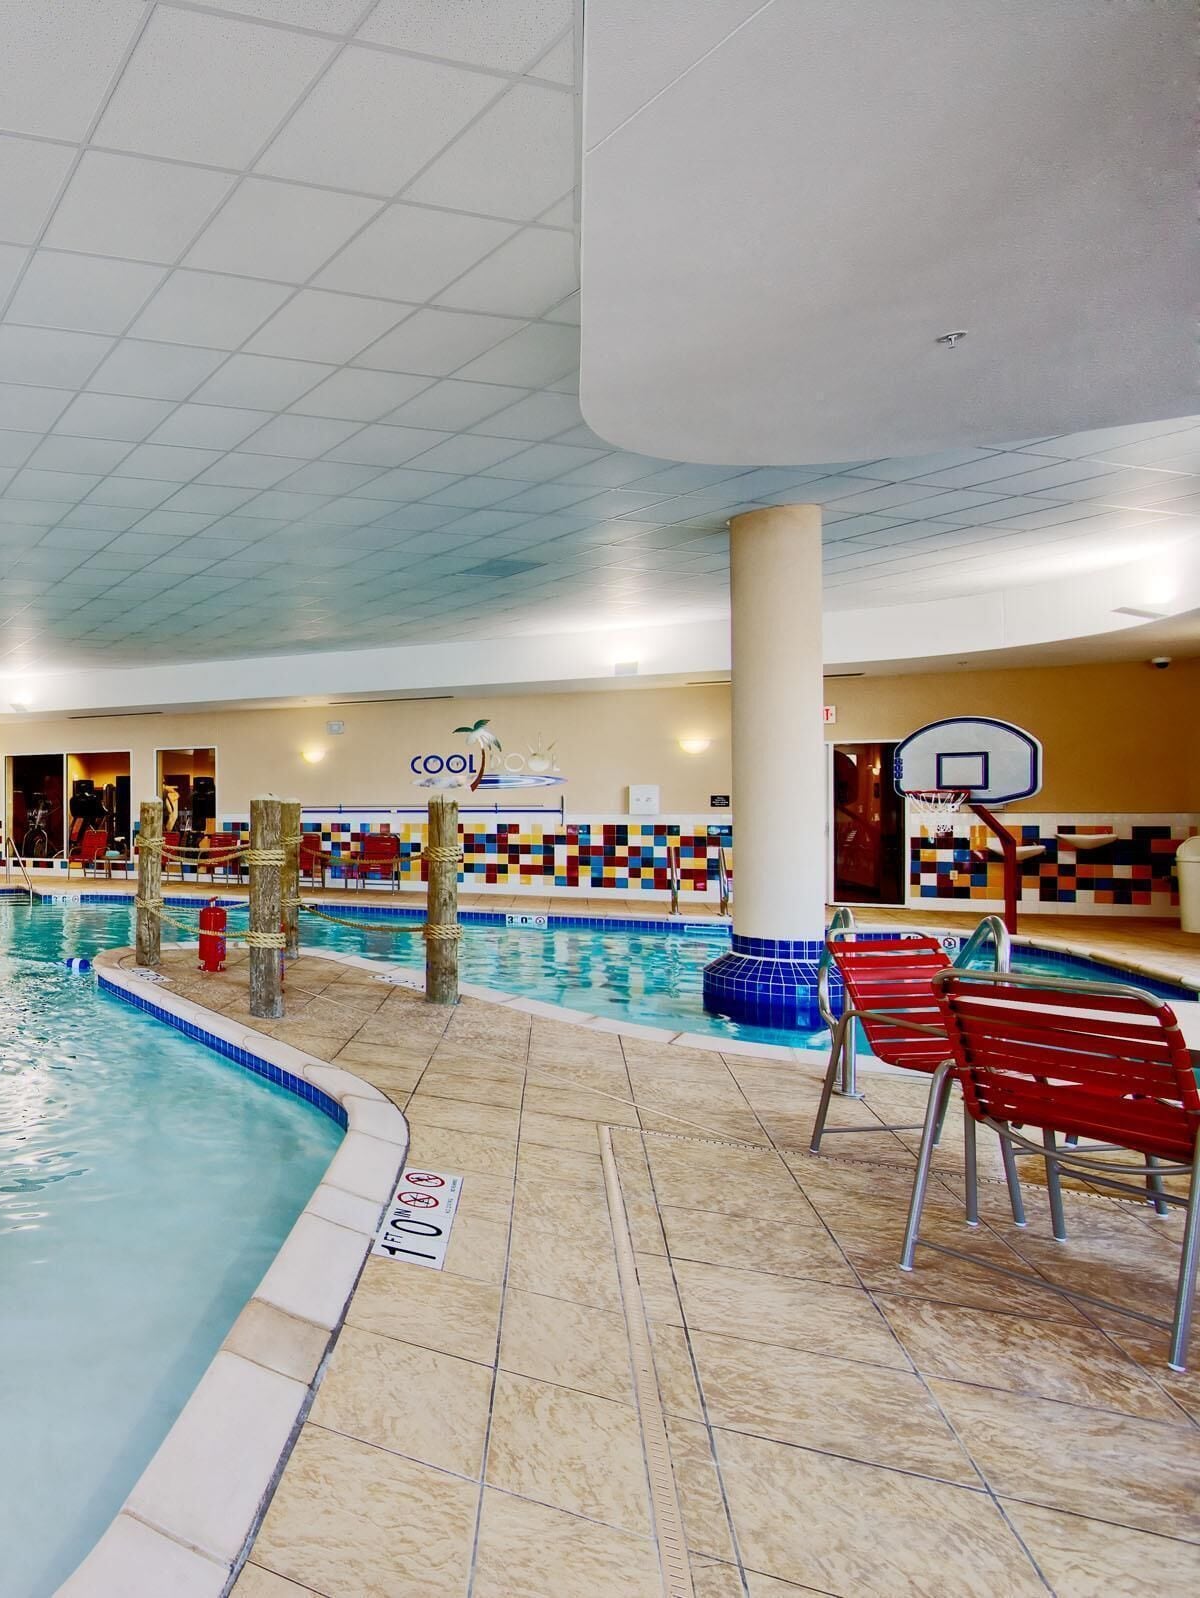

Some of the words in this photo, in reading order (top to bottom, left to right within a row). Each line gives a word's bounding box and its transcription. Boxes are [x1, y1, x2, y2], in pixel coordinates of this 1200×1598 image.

[410, 753, 477, 774] COOL
[507, 915, 514, 924] 3
[393, 1207, 412, 1218] IN
[390, 1218, 443, 1237] 0
[383, 1231, 403, 1244] FT
[381, 1243, 436, 1260] 1
